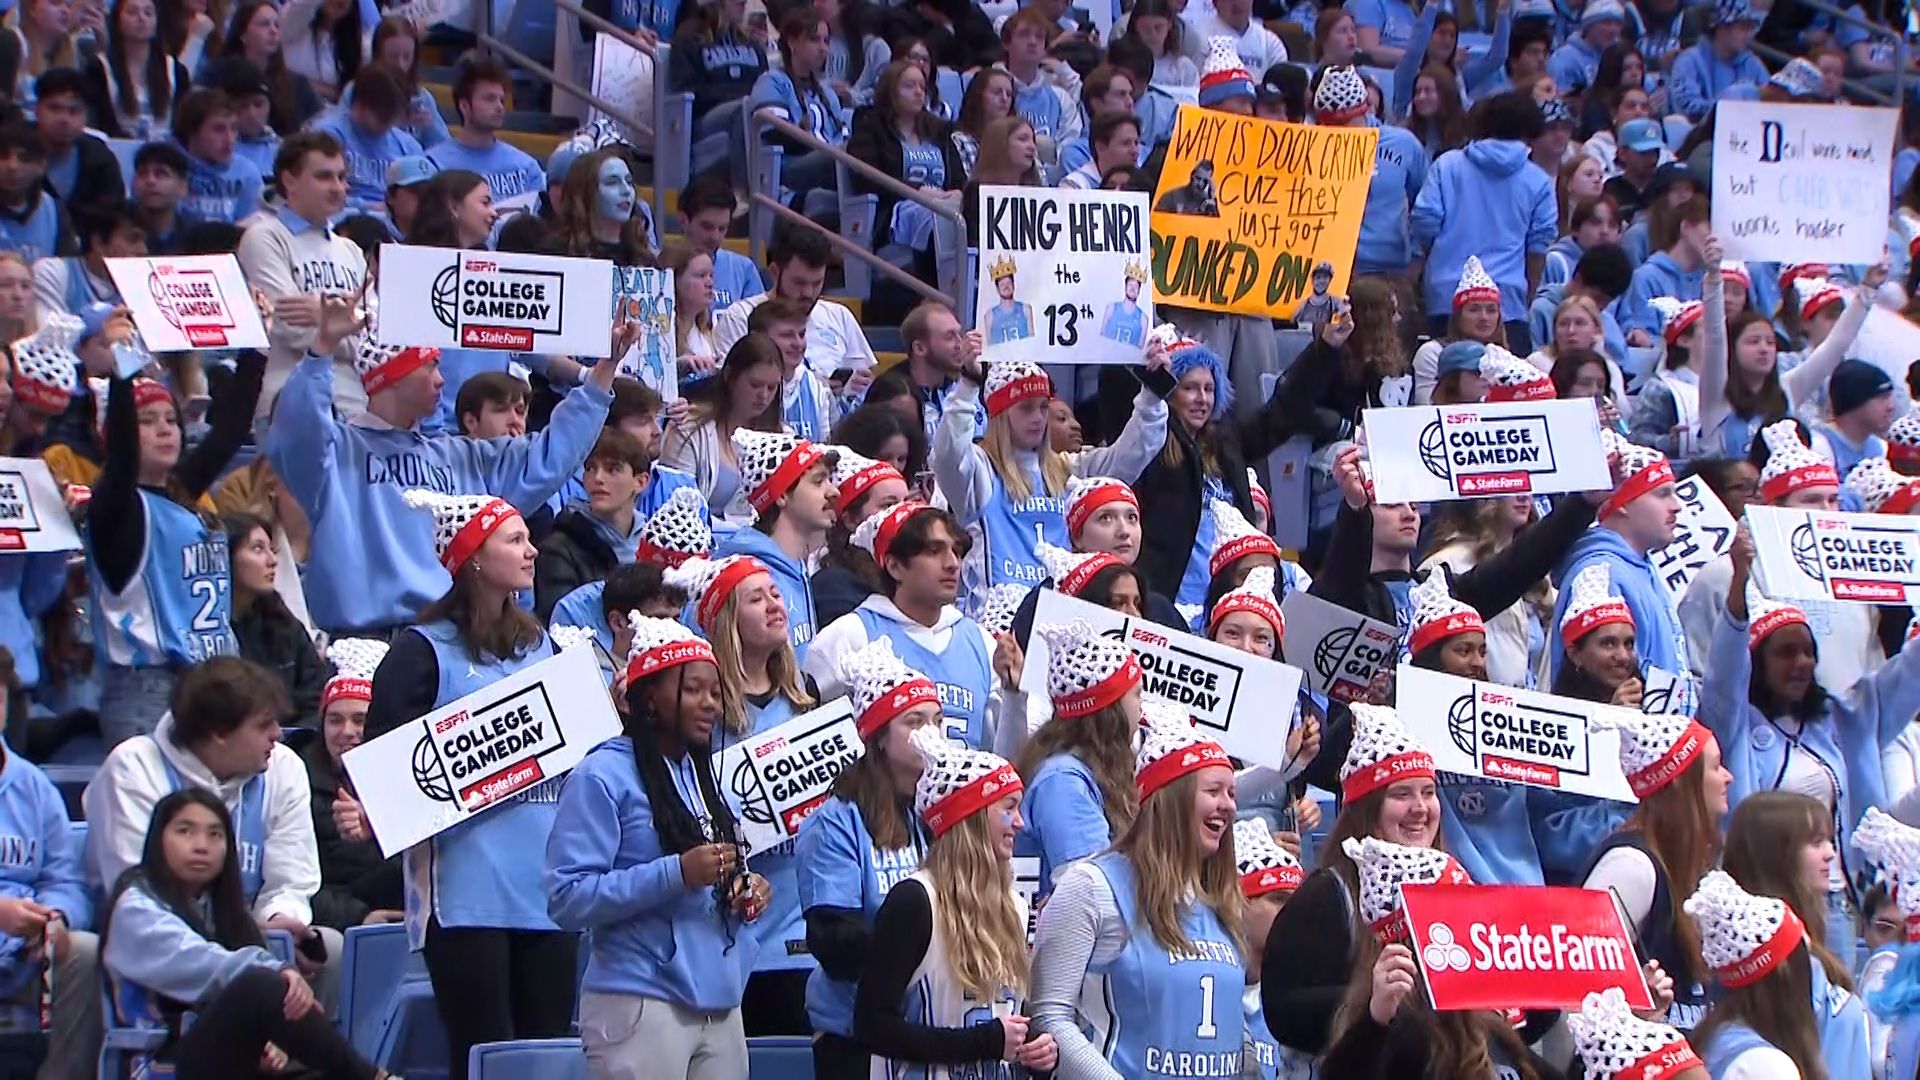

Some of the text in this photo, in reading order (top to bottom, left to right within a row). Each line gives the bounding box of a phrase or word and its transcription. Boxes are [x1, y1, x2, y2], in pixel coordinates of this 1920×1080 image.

[1175, 108, 1378, 182] WHY IS DOOK CRYIN?
[1729, 130, 1749, 154] the
[1729, 174, 1759, 196] but
[985, 195, 1142, 254] KING HENRI
[1228, 207, 1326, 256] just got
[293, 260, 361, 294] CAROLIN
[1054, 263, 1081, 285] the
[1265, 250, 1313, 307] ON
[167, 282, 216, 299] COLLEGE
[463, 278, 545, 302] COLLEGE
[175, 301, 223, 318] GAMEDAY
[462, 299, 551, 321] GAMEDAY
[1449, 428, 1533, 448] COLLEGE
[1452, 446, 1540, 467] GAMEDAY
[1013, 496, 1065, 515] NORTH
[1820, 537, 1907, 556] COLLEGE
[1825, 554, 1916, 575] GAMEDAY
[443, 704, 534, 758] COLLEGE
[1480, 710, 1569, 741] COLLEGE
[451, 721, 545, 780] GAMEDAY
[763, 733, 848, 783] COLLEGE
[1480, 731, 1577, 761] GAMEDAY
[771, 749, 859, 803] GAMEDAY
[1167, 939, 1238, 967] NORTH
[1196, 973, 1217, 1040] 1
